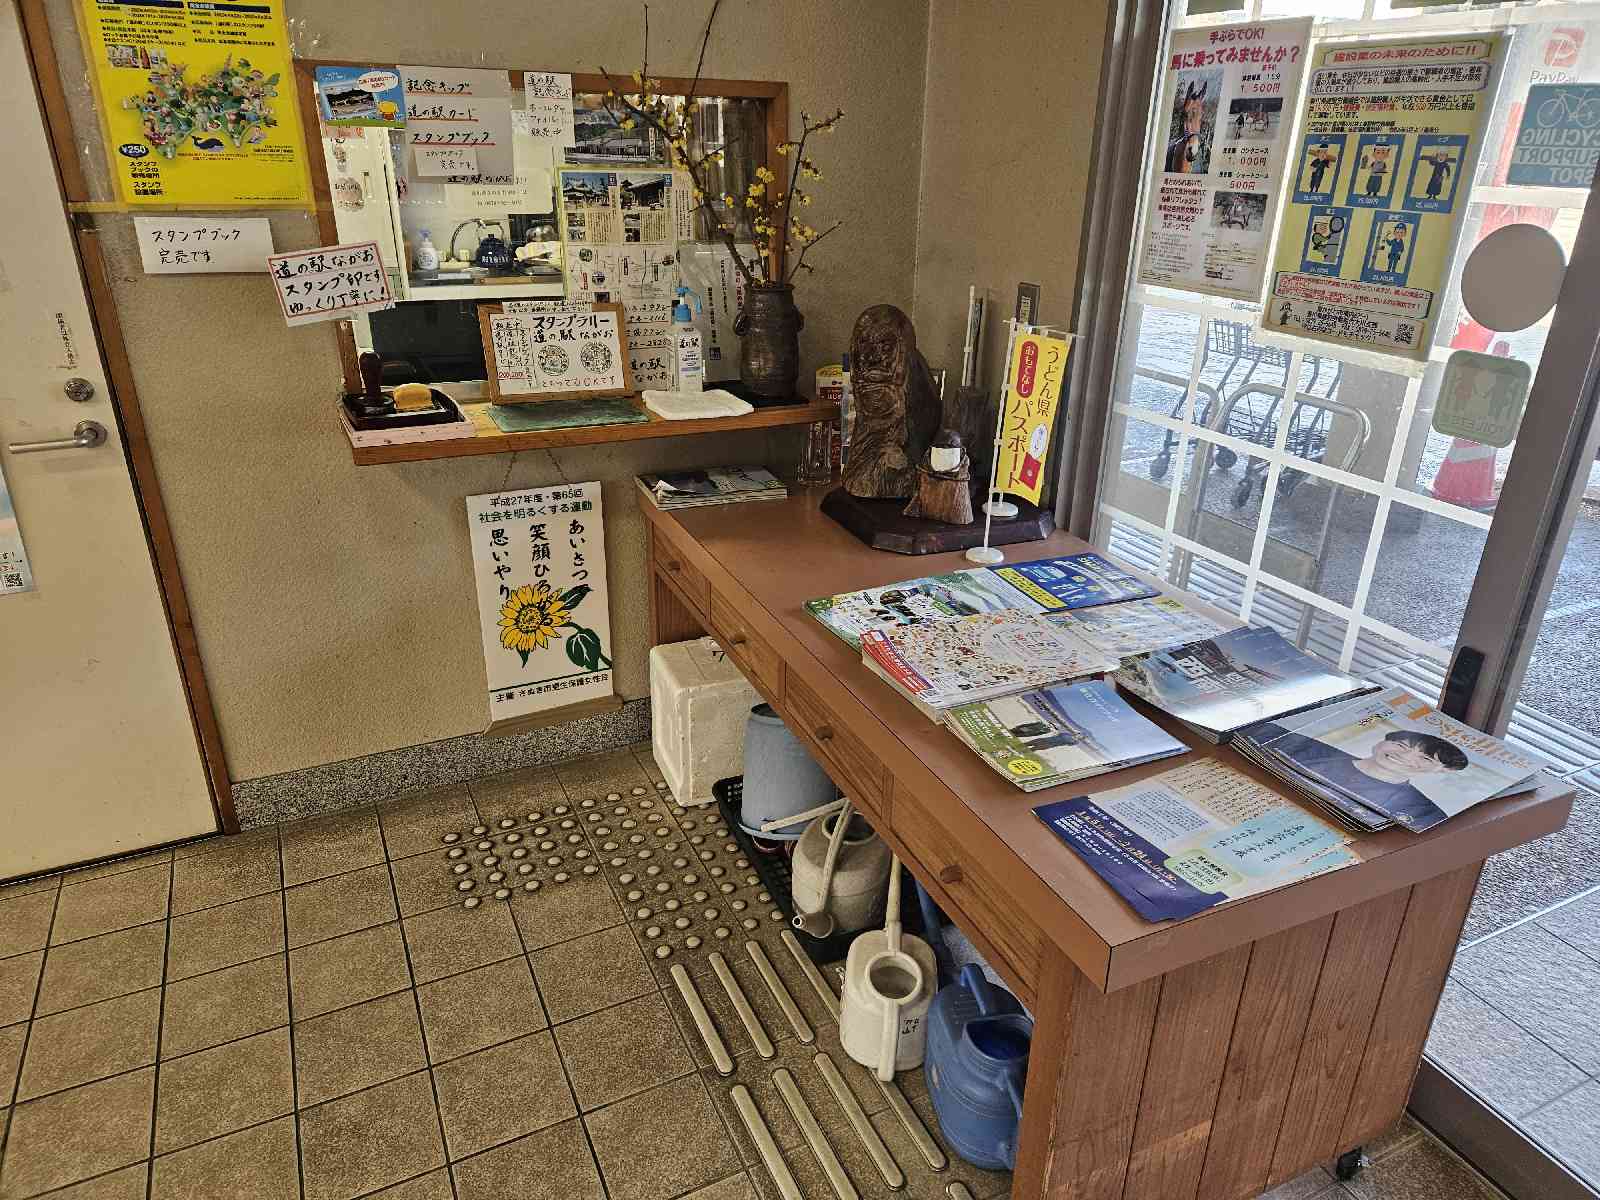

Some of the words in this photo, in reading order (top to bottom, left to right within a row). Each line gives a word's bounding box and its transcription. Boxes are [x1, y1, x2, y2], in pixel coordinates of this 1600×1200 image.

[1171, 46, 1300, 71] 馬に乗ってみませんか?
[274, 247, 374, 280] 道の駅ながお
[532, 314, 610, 330] スタンプラリー
[1037, 346, 1059, 417] うどん県
[1008, 399, 1034, 489] パスポート
[479, 499, 593, 524] 社会を明るくする運動
[489, 488, 584, 508] 平成27年度・第65回
[489, 528, 513, 600] 思いやり
[568, 519, 589, 581] あいさつ
